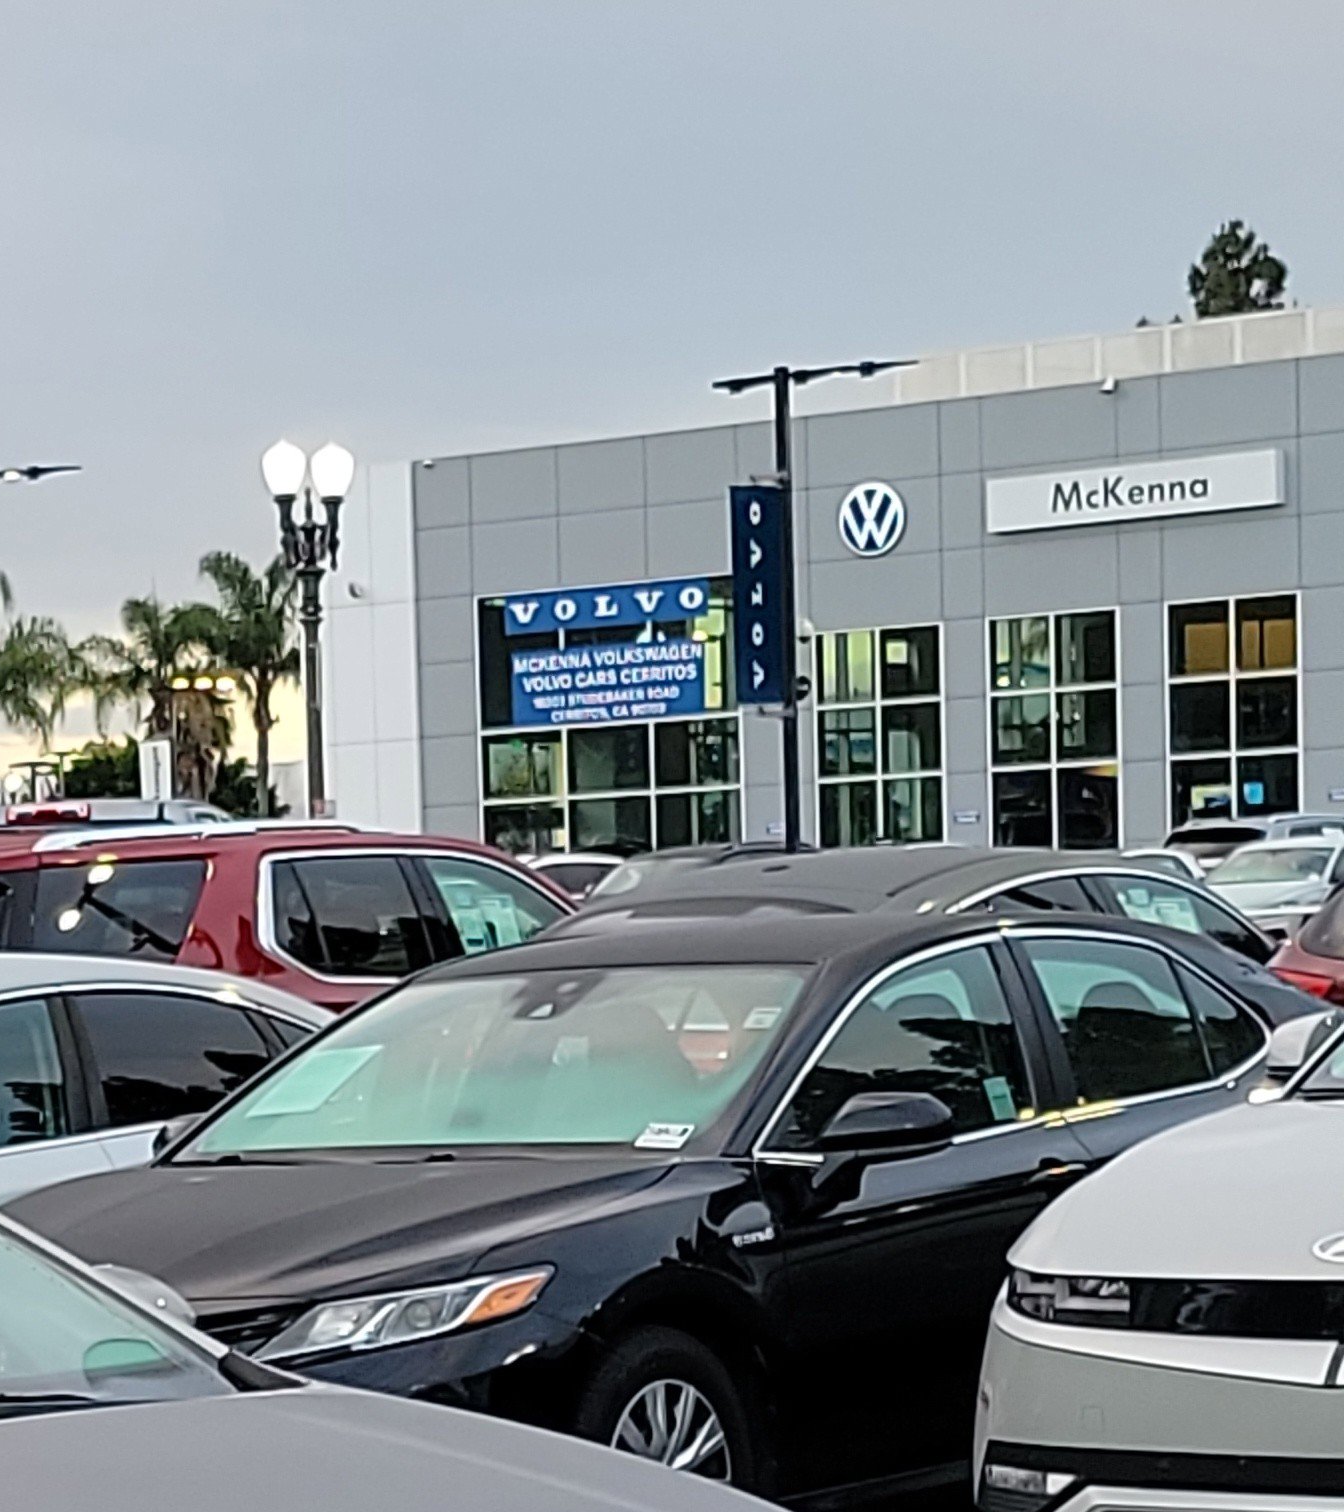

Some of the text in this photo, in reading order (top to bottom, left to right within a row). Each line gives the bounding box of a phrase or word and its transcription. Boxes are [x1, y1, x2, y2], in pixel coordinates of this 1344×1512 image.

[1050, 475, 1210, 514] McKenna
[509, 587, 704, 624] VOLVO
[749, 500, 765, 691] VOLVO
[514, 644, 703, 674] MCKENNA VOLKSWAGEN
[522, 663, 698, 693] VOLVO CARS CERRITOS
